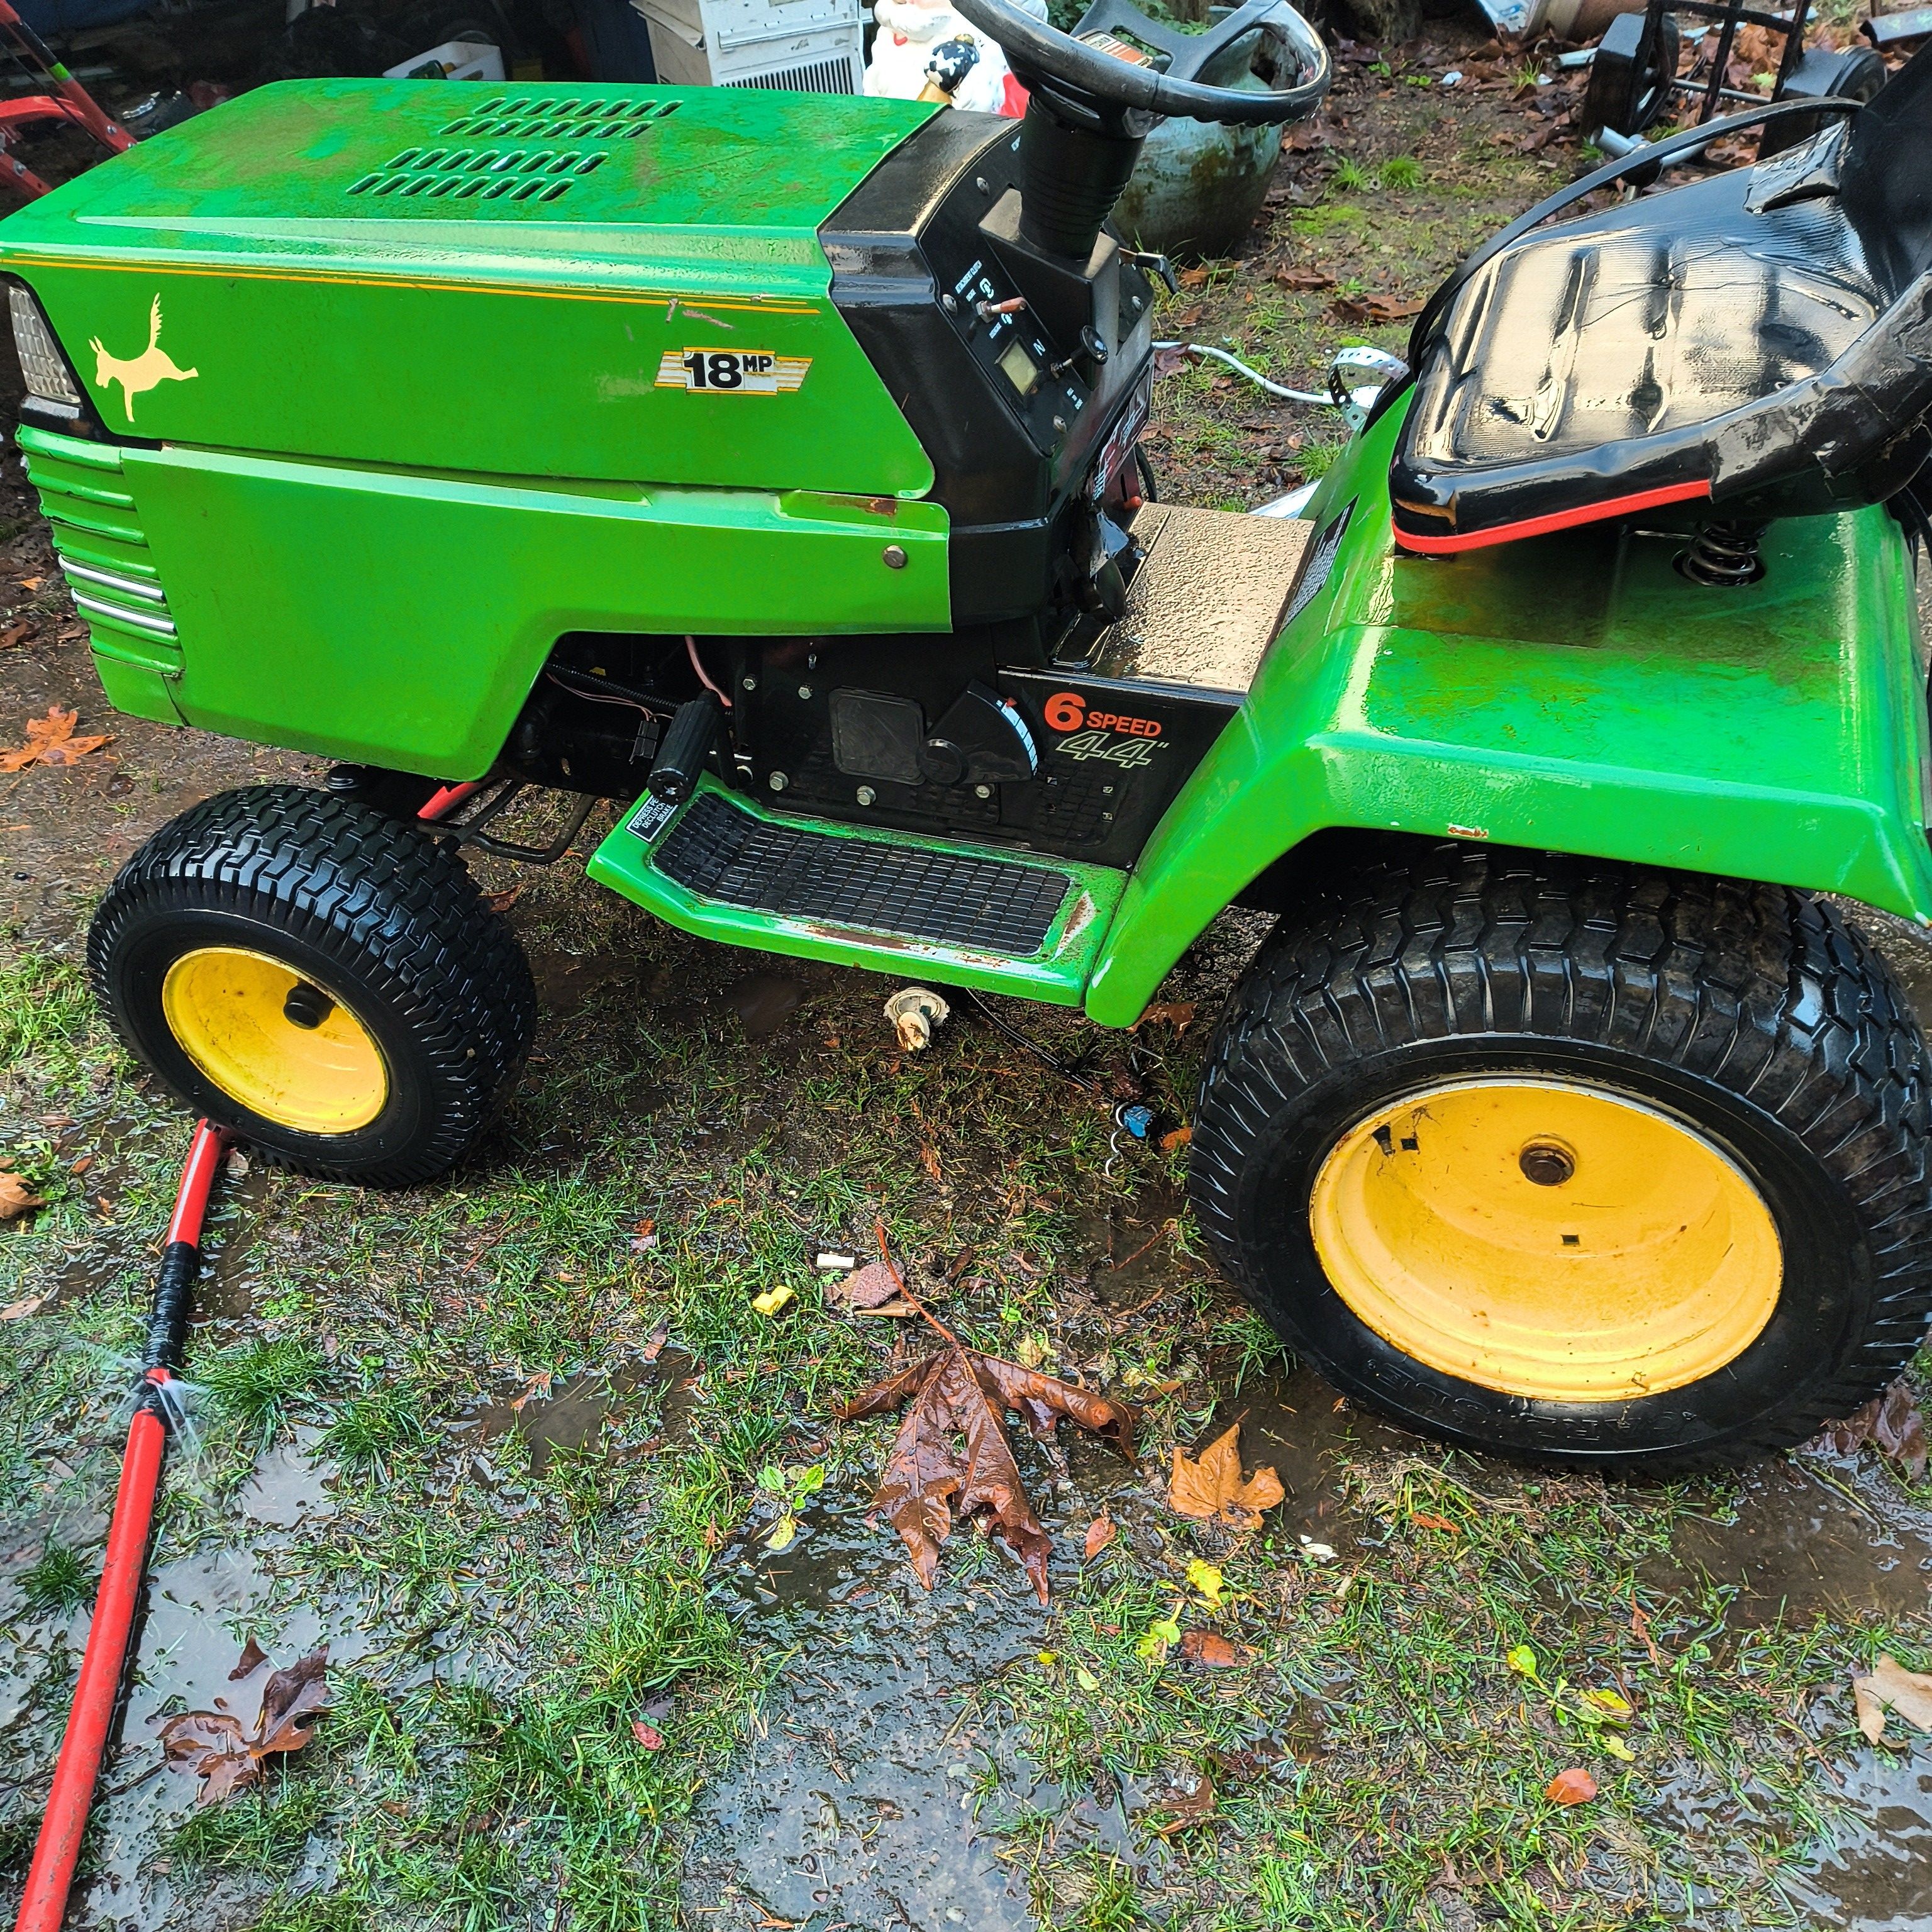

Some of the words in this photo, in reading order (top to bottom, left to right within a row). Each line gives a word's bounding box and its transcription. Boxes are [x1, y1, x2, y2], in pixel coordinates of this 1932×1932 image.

[684, 353, 742, 389] 18
[1045, 692, 1086, 731] 6
[1087, 711, 1162, 737] SPEED
[632, 806, 653, 829] DEPRESS
[657, 804, 673, 822] BRAKE
